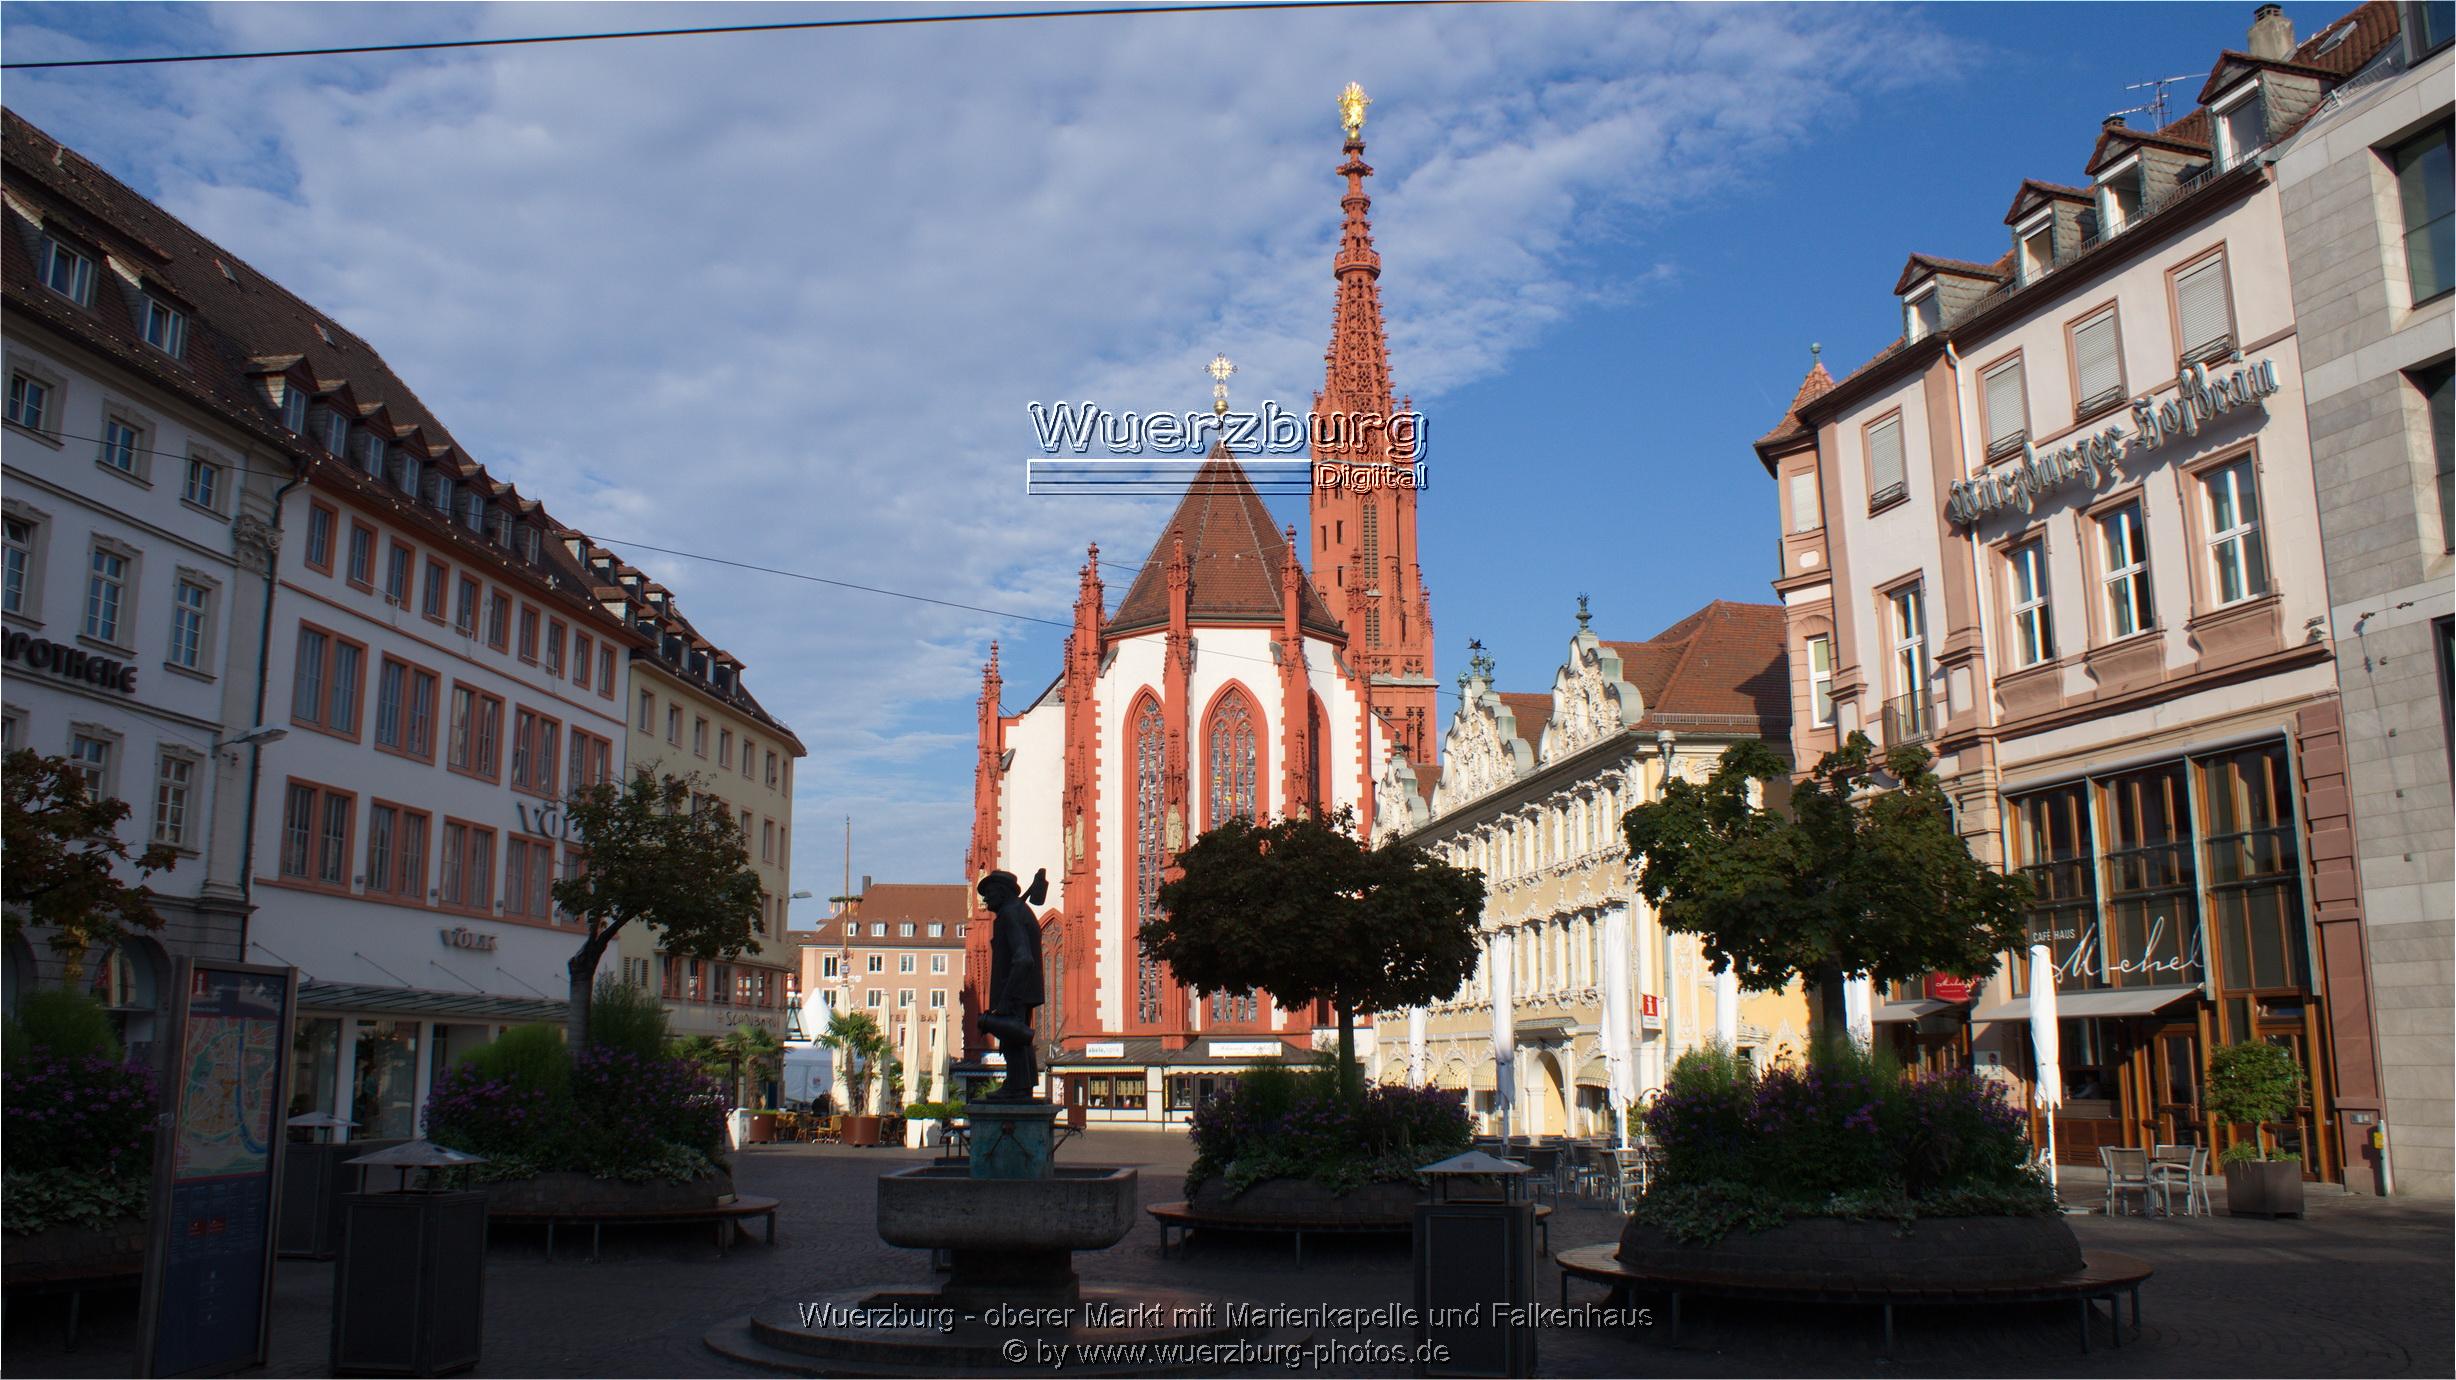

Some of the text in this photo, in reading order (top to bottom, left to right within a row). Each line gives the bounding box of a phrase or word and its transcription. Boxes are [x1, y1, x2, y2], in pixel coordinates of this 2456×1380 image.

[2032, 928, 2076, 942] CAFÉ HAUS
[2053, 916, 2205, 984] Mchel
